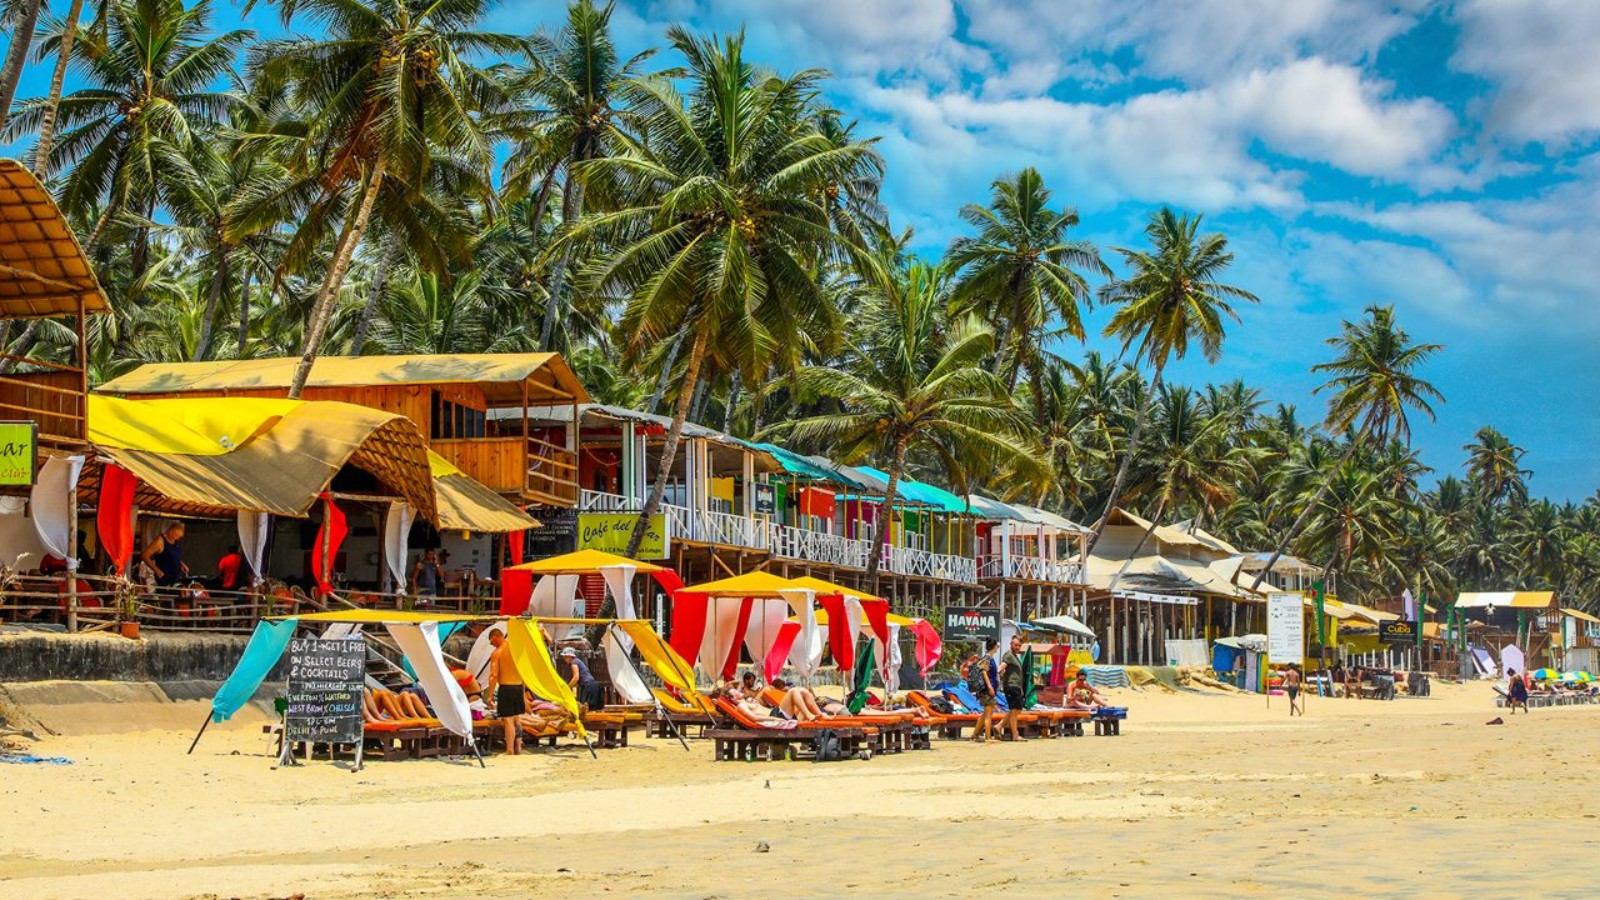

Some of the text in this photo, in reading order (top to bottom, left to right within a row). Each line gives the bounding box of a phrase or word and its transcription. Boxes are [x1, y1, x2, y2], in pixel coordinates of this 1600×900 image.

[0, 442, 28, 457] ar
[583, 521, 609, 543] Café
[612, 519, 632, 531] del
[948, 614, 996, 629] HAVANA
[1387, 624, 1411, 633] Cuba
[291, 639, 309, 653] BUY
[325, 640, 340, 651] GET
[349, 641, 366, 652] FREE
[291, 656, 362, 669] ON SELECT BEERS
[300, 667, 349, 680] COCKTAILS
[288, 693, 319, 703] EVERTON
[324, 692, 351, 701] WATFORD
[288, 704, 305, 713] WEST
[305, 703, 323, 713] BROM
[328, 703, 355, 712] CHELSEA
[287, 725, 310, 735] DELHI
[319, 725, 338, 735] PUNE
